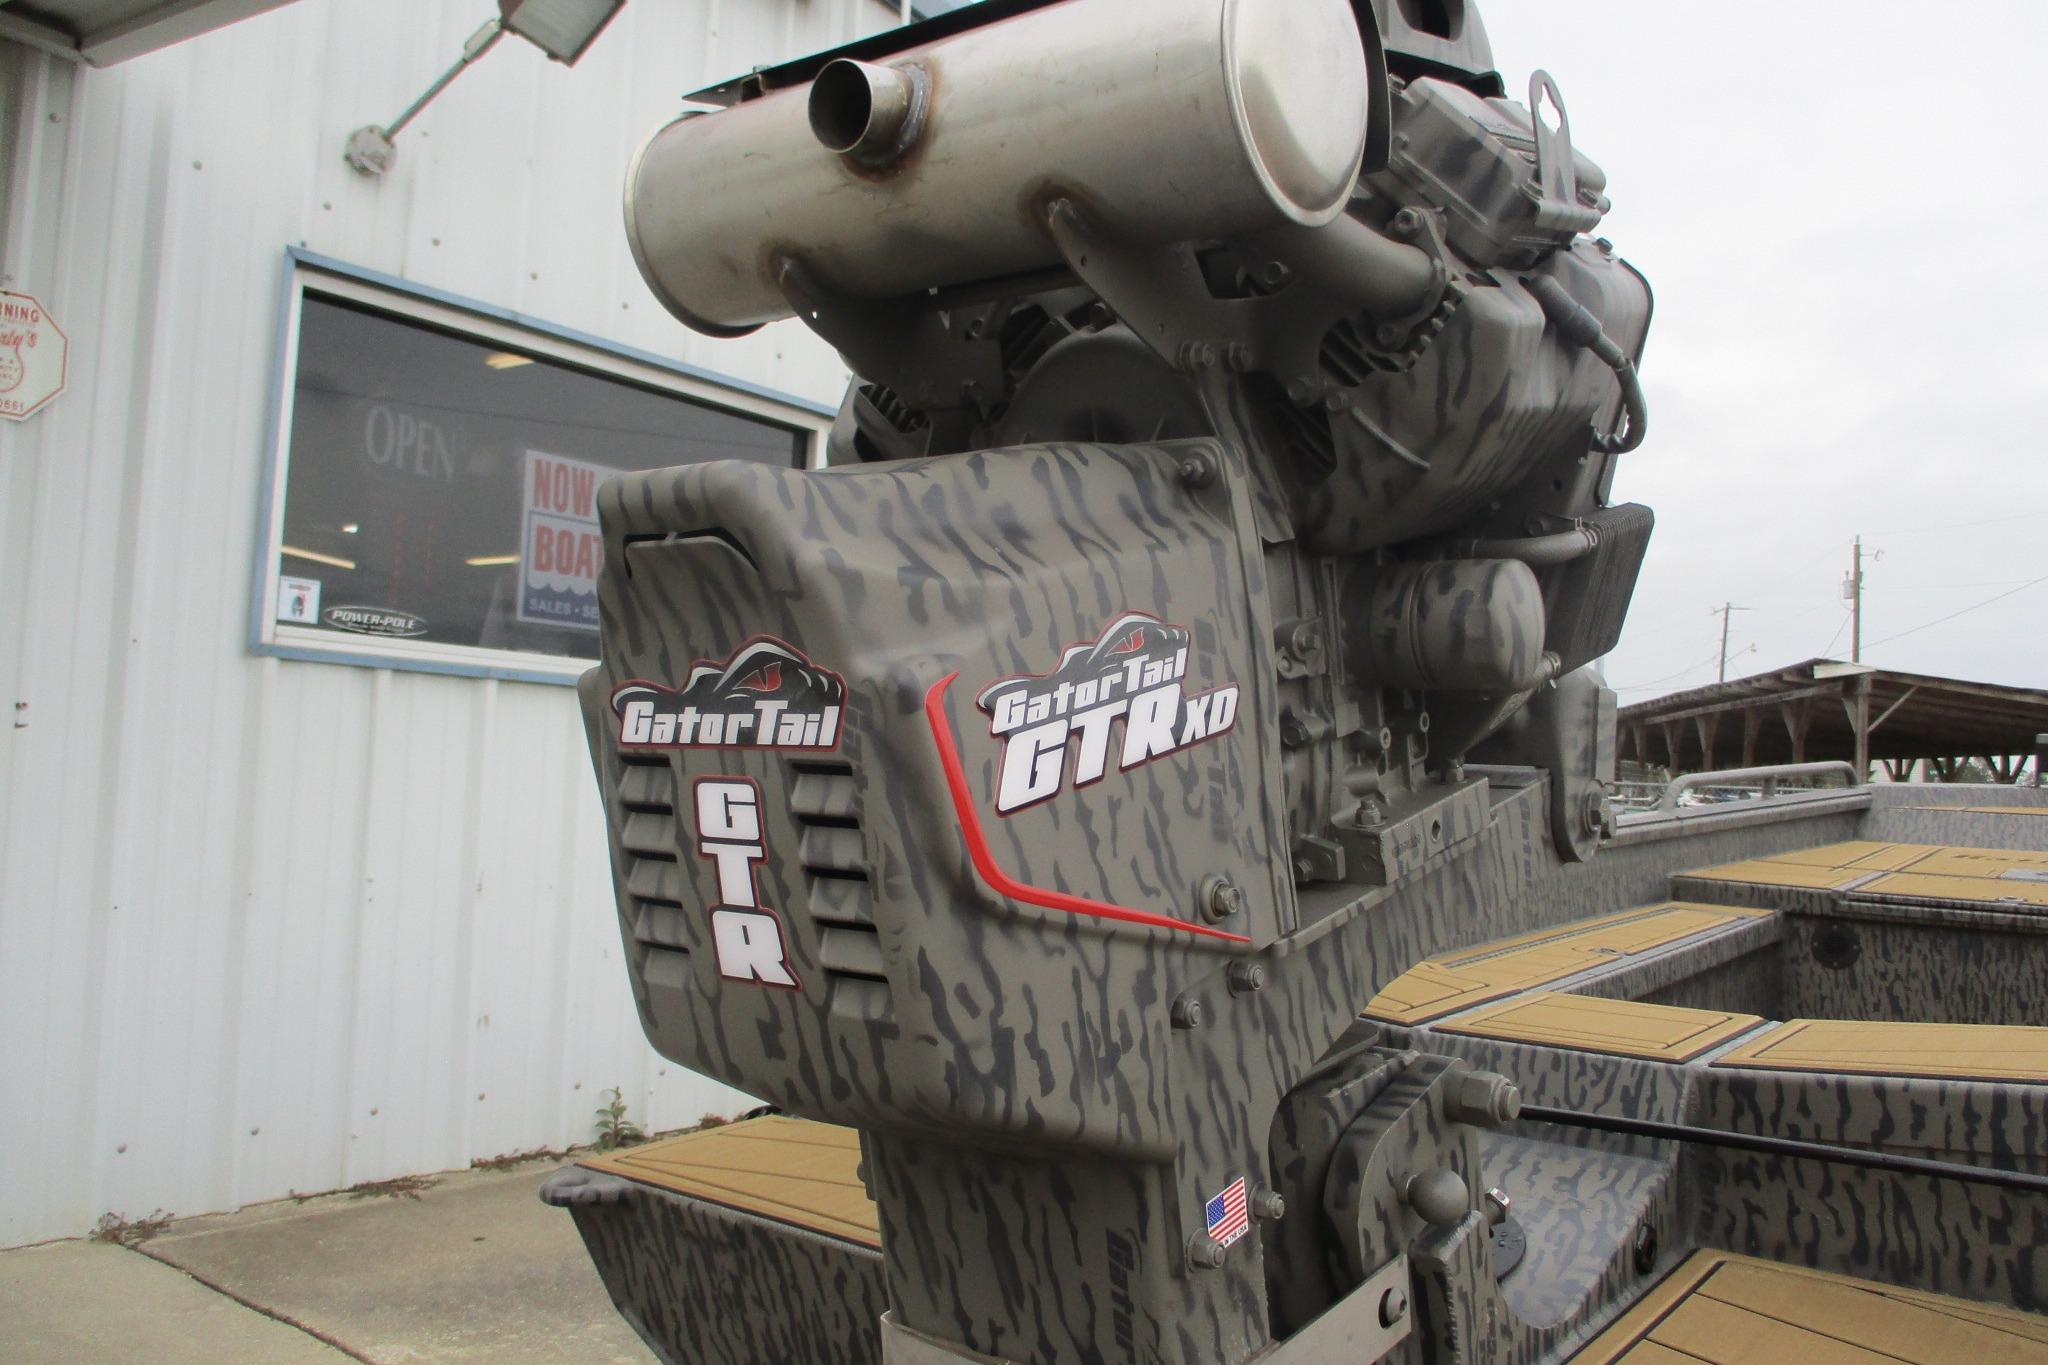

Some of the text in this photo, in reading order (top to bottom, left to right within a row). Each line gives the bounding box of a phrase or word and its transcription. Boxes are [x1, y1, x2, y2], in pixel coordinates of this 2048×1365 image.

[0, 303, 39, 323] NING
[366, 406, 454, 482] OPEN
[533, 458, 596, 518] NOW
[529, 597, 571, 615] SALES
[332, 610, 415, 629] POWER-POLE
